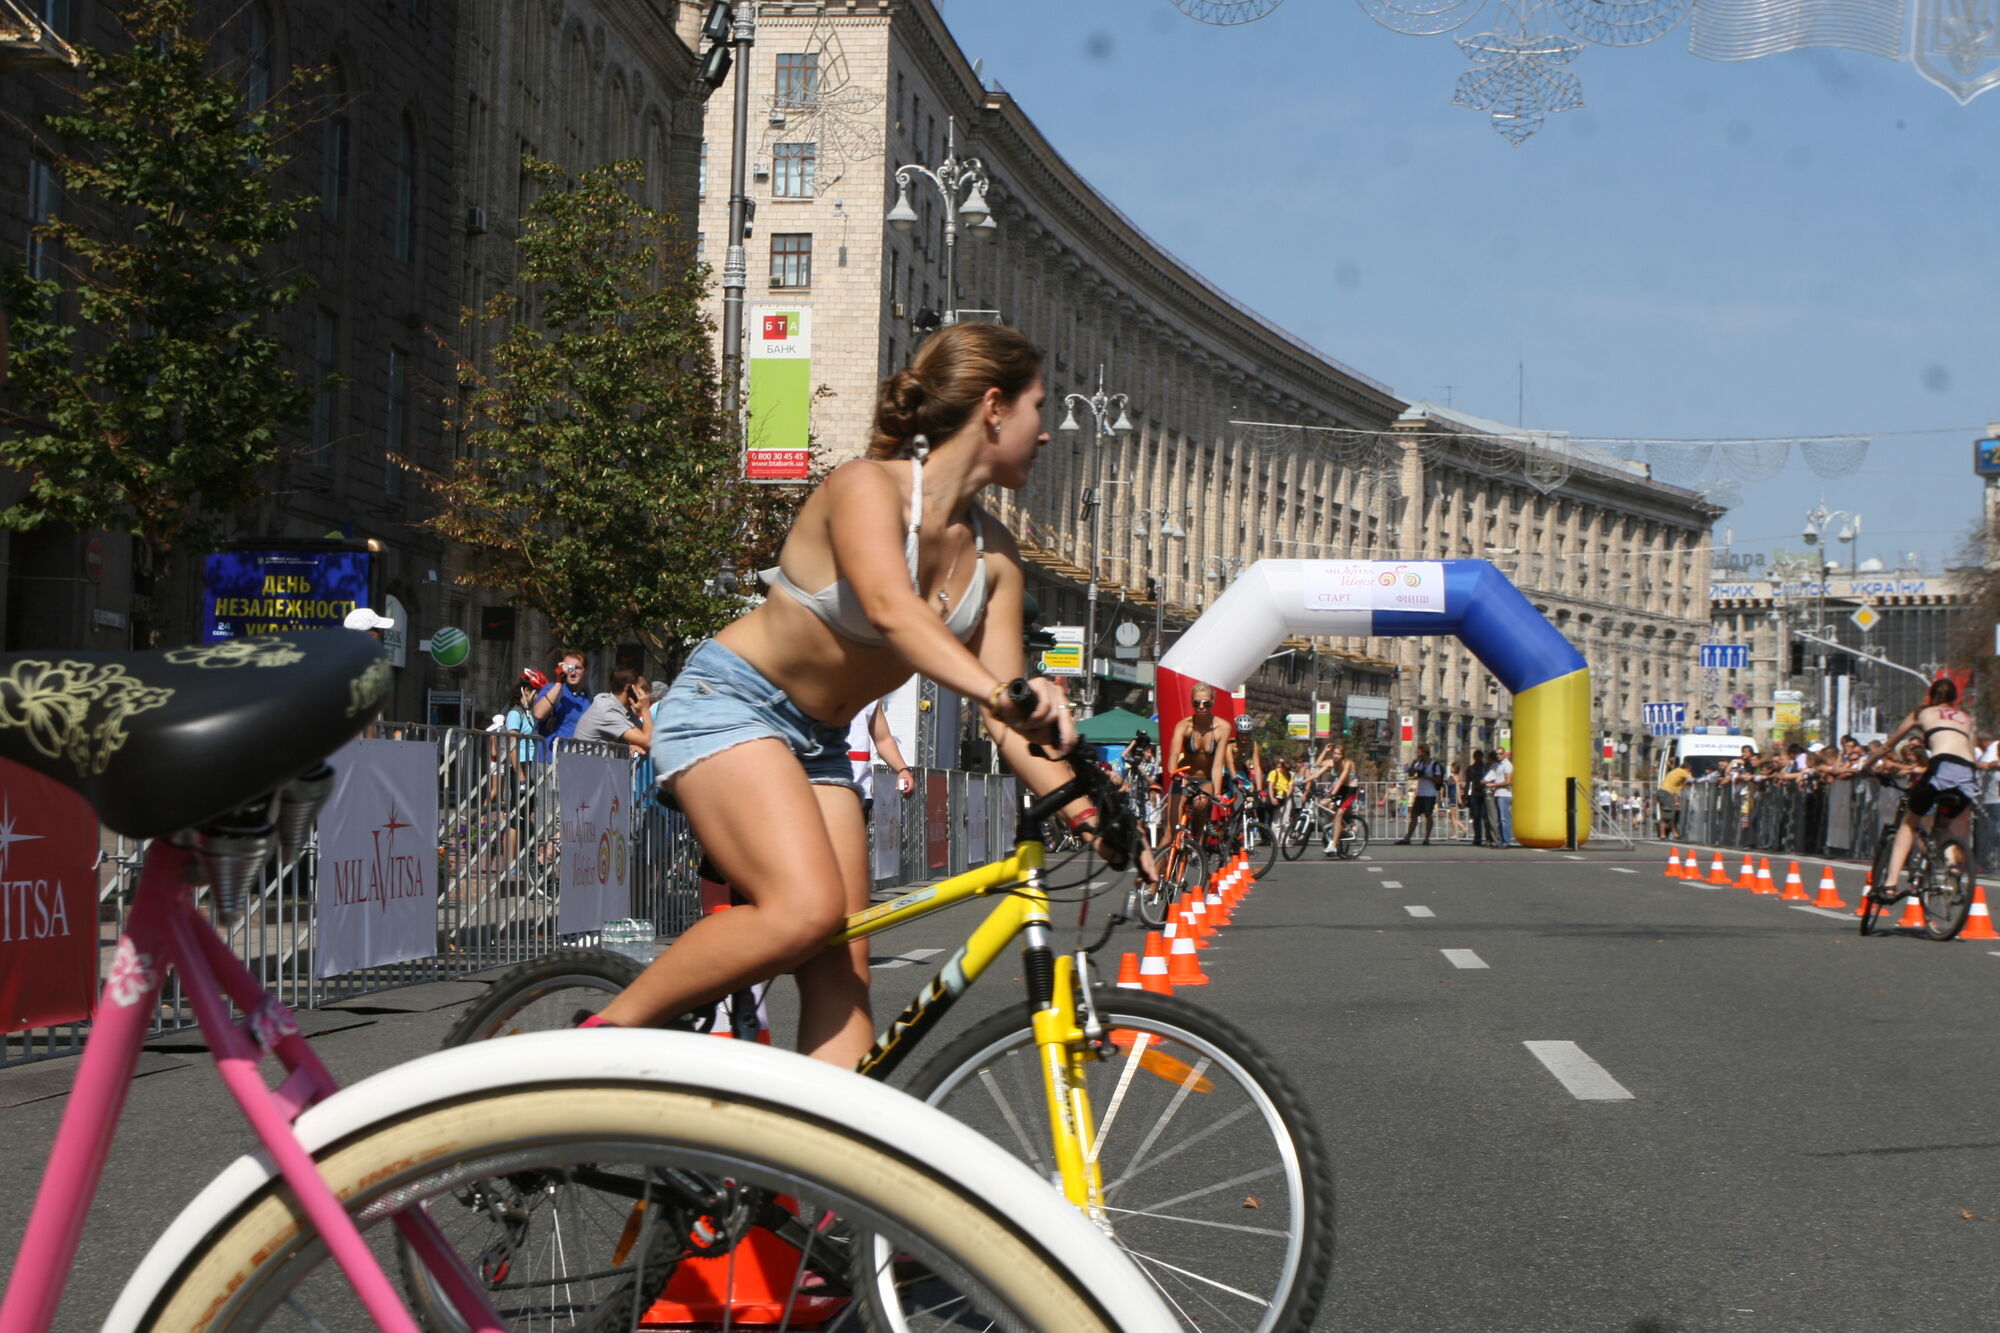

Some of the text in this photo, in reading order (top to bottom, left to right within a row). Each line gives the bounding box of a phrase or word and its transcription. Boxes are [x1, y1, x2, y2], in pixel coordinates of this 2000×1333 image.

[766, 345, 796, 354] БАНК
[758, 452, 771, 460] 800
[773, 452, 782, 460] 30
[783, 452, 793, 460] 45
[794, 452, 804, 460] 45
[262, 575, 311, 596] ДЕНЬ
[1850, 579, 1926, 595] УКРАЇНИ
[1318, 592, 1352, 602] СТАРТ
[215, 598, 358, 620] НЕЗАЛЕЖНОСТІ
[333, 829, 425, 914] MILAVITSA
[0, 876, 71, 942] ITSA
